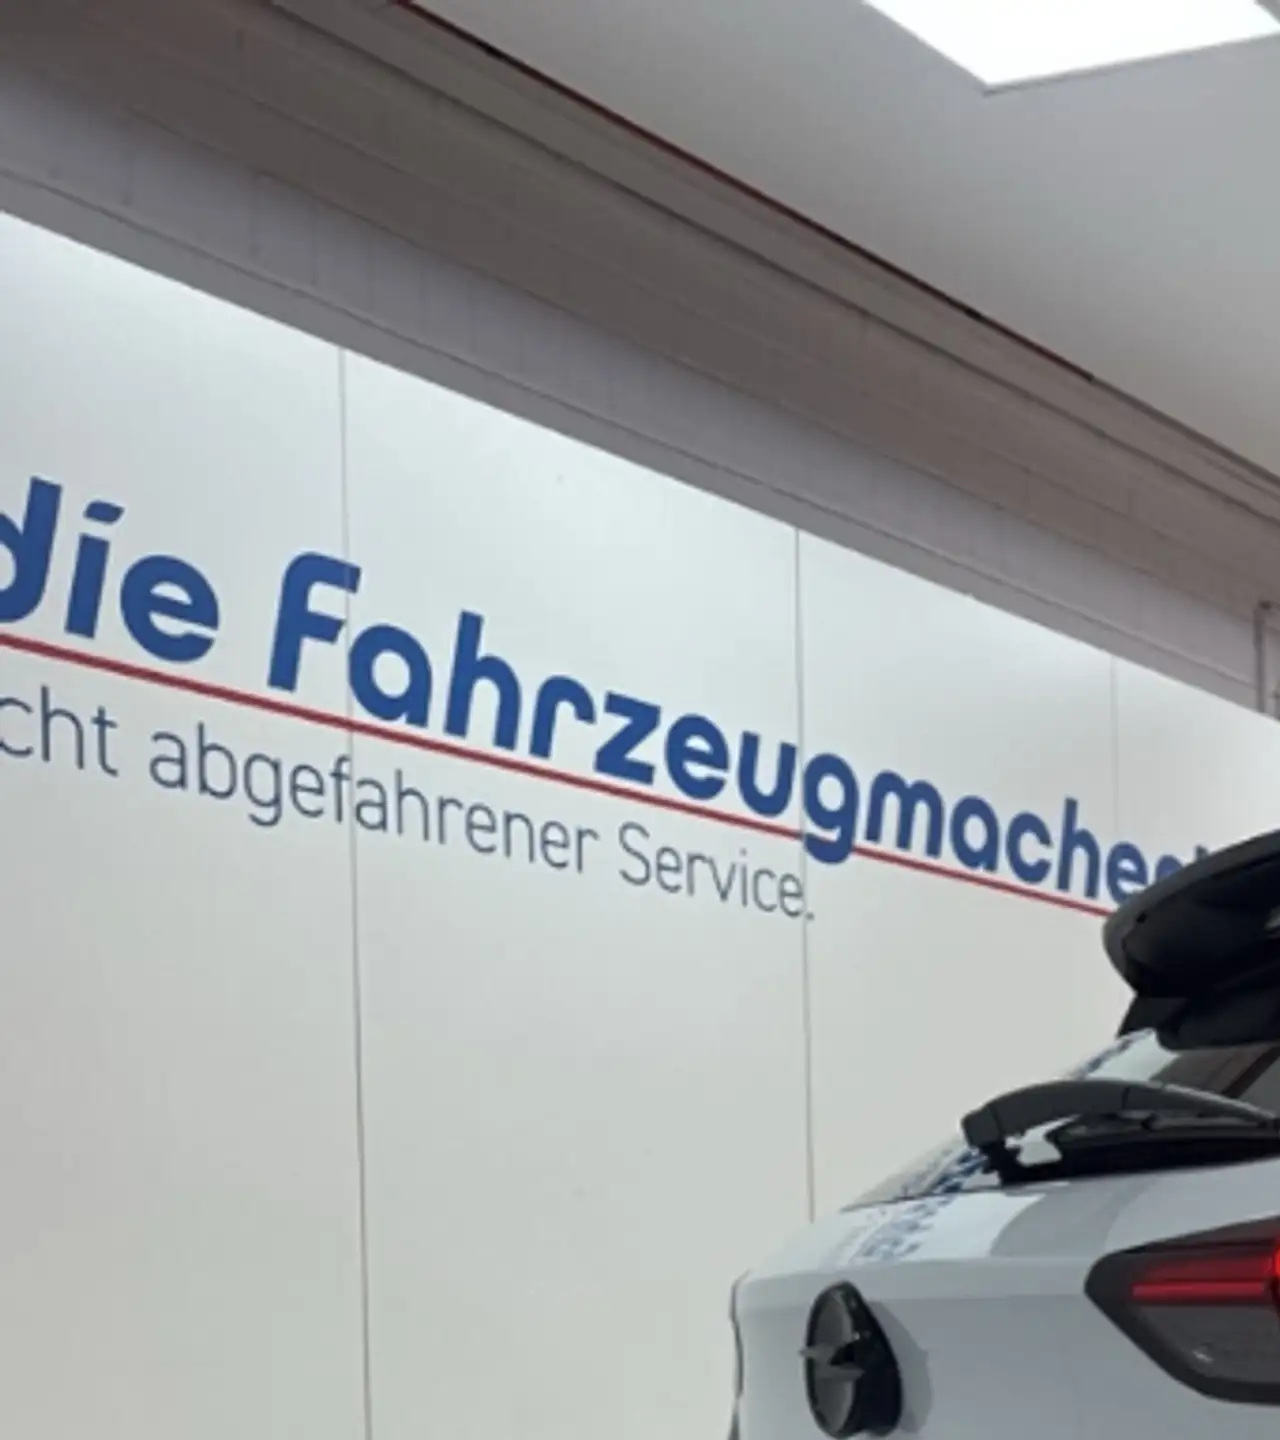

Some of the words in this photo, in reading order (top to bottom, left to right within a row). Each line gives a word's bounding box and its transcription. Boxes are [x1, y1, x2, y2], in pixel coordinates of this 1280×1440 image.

[0, 476, 219, 662] die
[149, 721, 599, 874] abgefahrener
[618, 821, 814, 920] Service.
